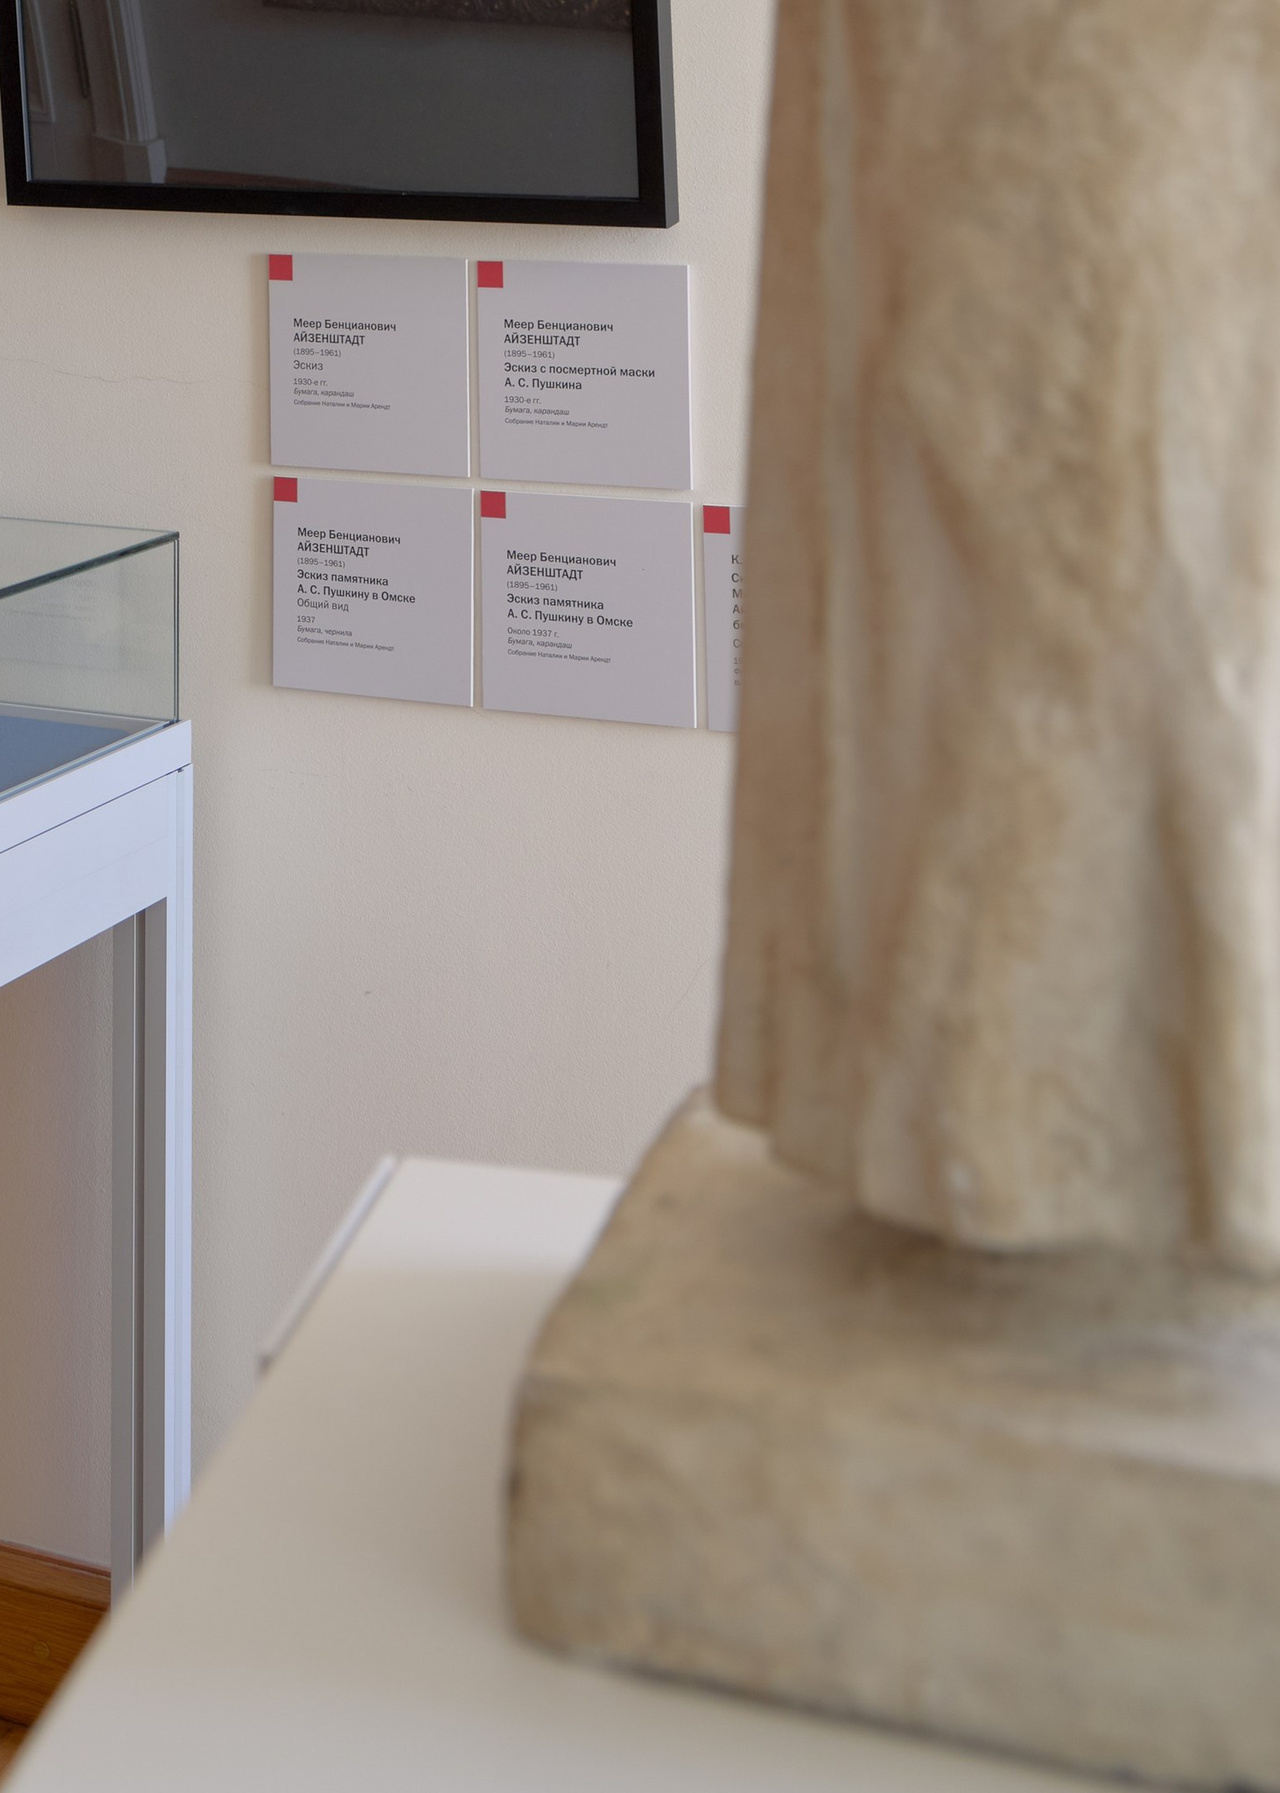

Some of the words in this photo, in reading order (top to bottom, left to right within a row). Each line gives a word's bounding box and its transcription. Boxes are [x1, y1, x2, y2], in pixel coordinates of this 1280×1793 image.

[293, 318, 322, 329] Меер
[325, 320, 396, 332] Бенцианович
[504, 319, 534, 330] Меер
[537, 320, 613, 332] Бенцианович
[293, 331, 365, 346] АЙЗЕНШТАДТ
[504, 332, 580, 347] АЙЗЕНШТАДТ
[293, 360, 323, 371] Эскиз
[504, 363, 537, 373] Эскиз
[540, 365, 546, 373] с
[549, 365, 617, 377] посмертной
[620, 368, 655, 378] маски
[505, 378, 515, 387] А.
[518, 378, 528, 388] С.
[532, 379, 582, 390] Пушкина
[298, 527, 326, 539] Меер
[329, 530, 401, 544] Бенцианович
[297, 540, 369, 557] АЙЗЕНШТАДТ
[507, 550, 537, 561] Меер
[540, 552, 616, 566] Бенцианович
[297, 569, 328, 581] Эскиз
[331, 573, 388, 586] памятника
[507, 564, 583, 580] АЙЗЕНШТАДТ
[297, 584, 307, 593] А.
[310, 585, 320, 595] С.
[323, 586, 369, 600] Пушкину
[381, 592, 415, 603] Омске
[297, 598, 329, 610] Общий
[332, 602, 349, 612] вид
[507, 593, 540, 605] Эскиз
[543, 597, 604, 610] памятника
[507, 609, 517, 618] А.
[521, 610, 532, 619] С.
[535, 610, 583, 625] Пушкину
[587, 616, 593, 624] в
[597, 616, 633, 628] Омске
[507, 627, 530, 636] Около
[533, 628, 552, 637] 1937
